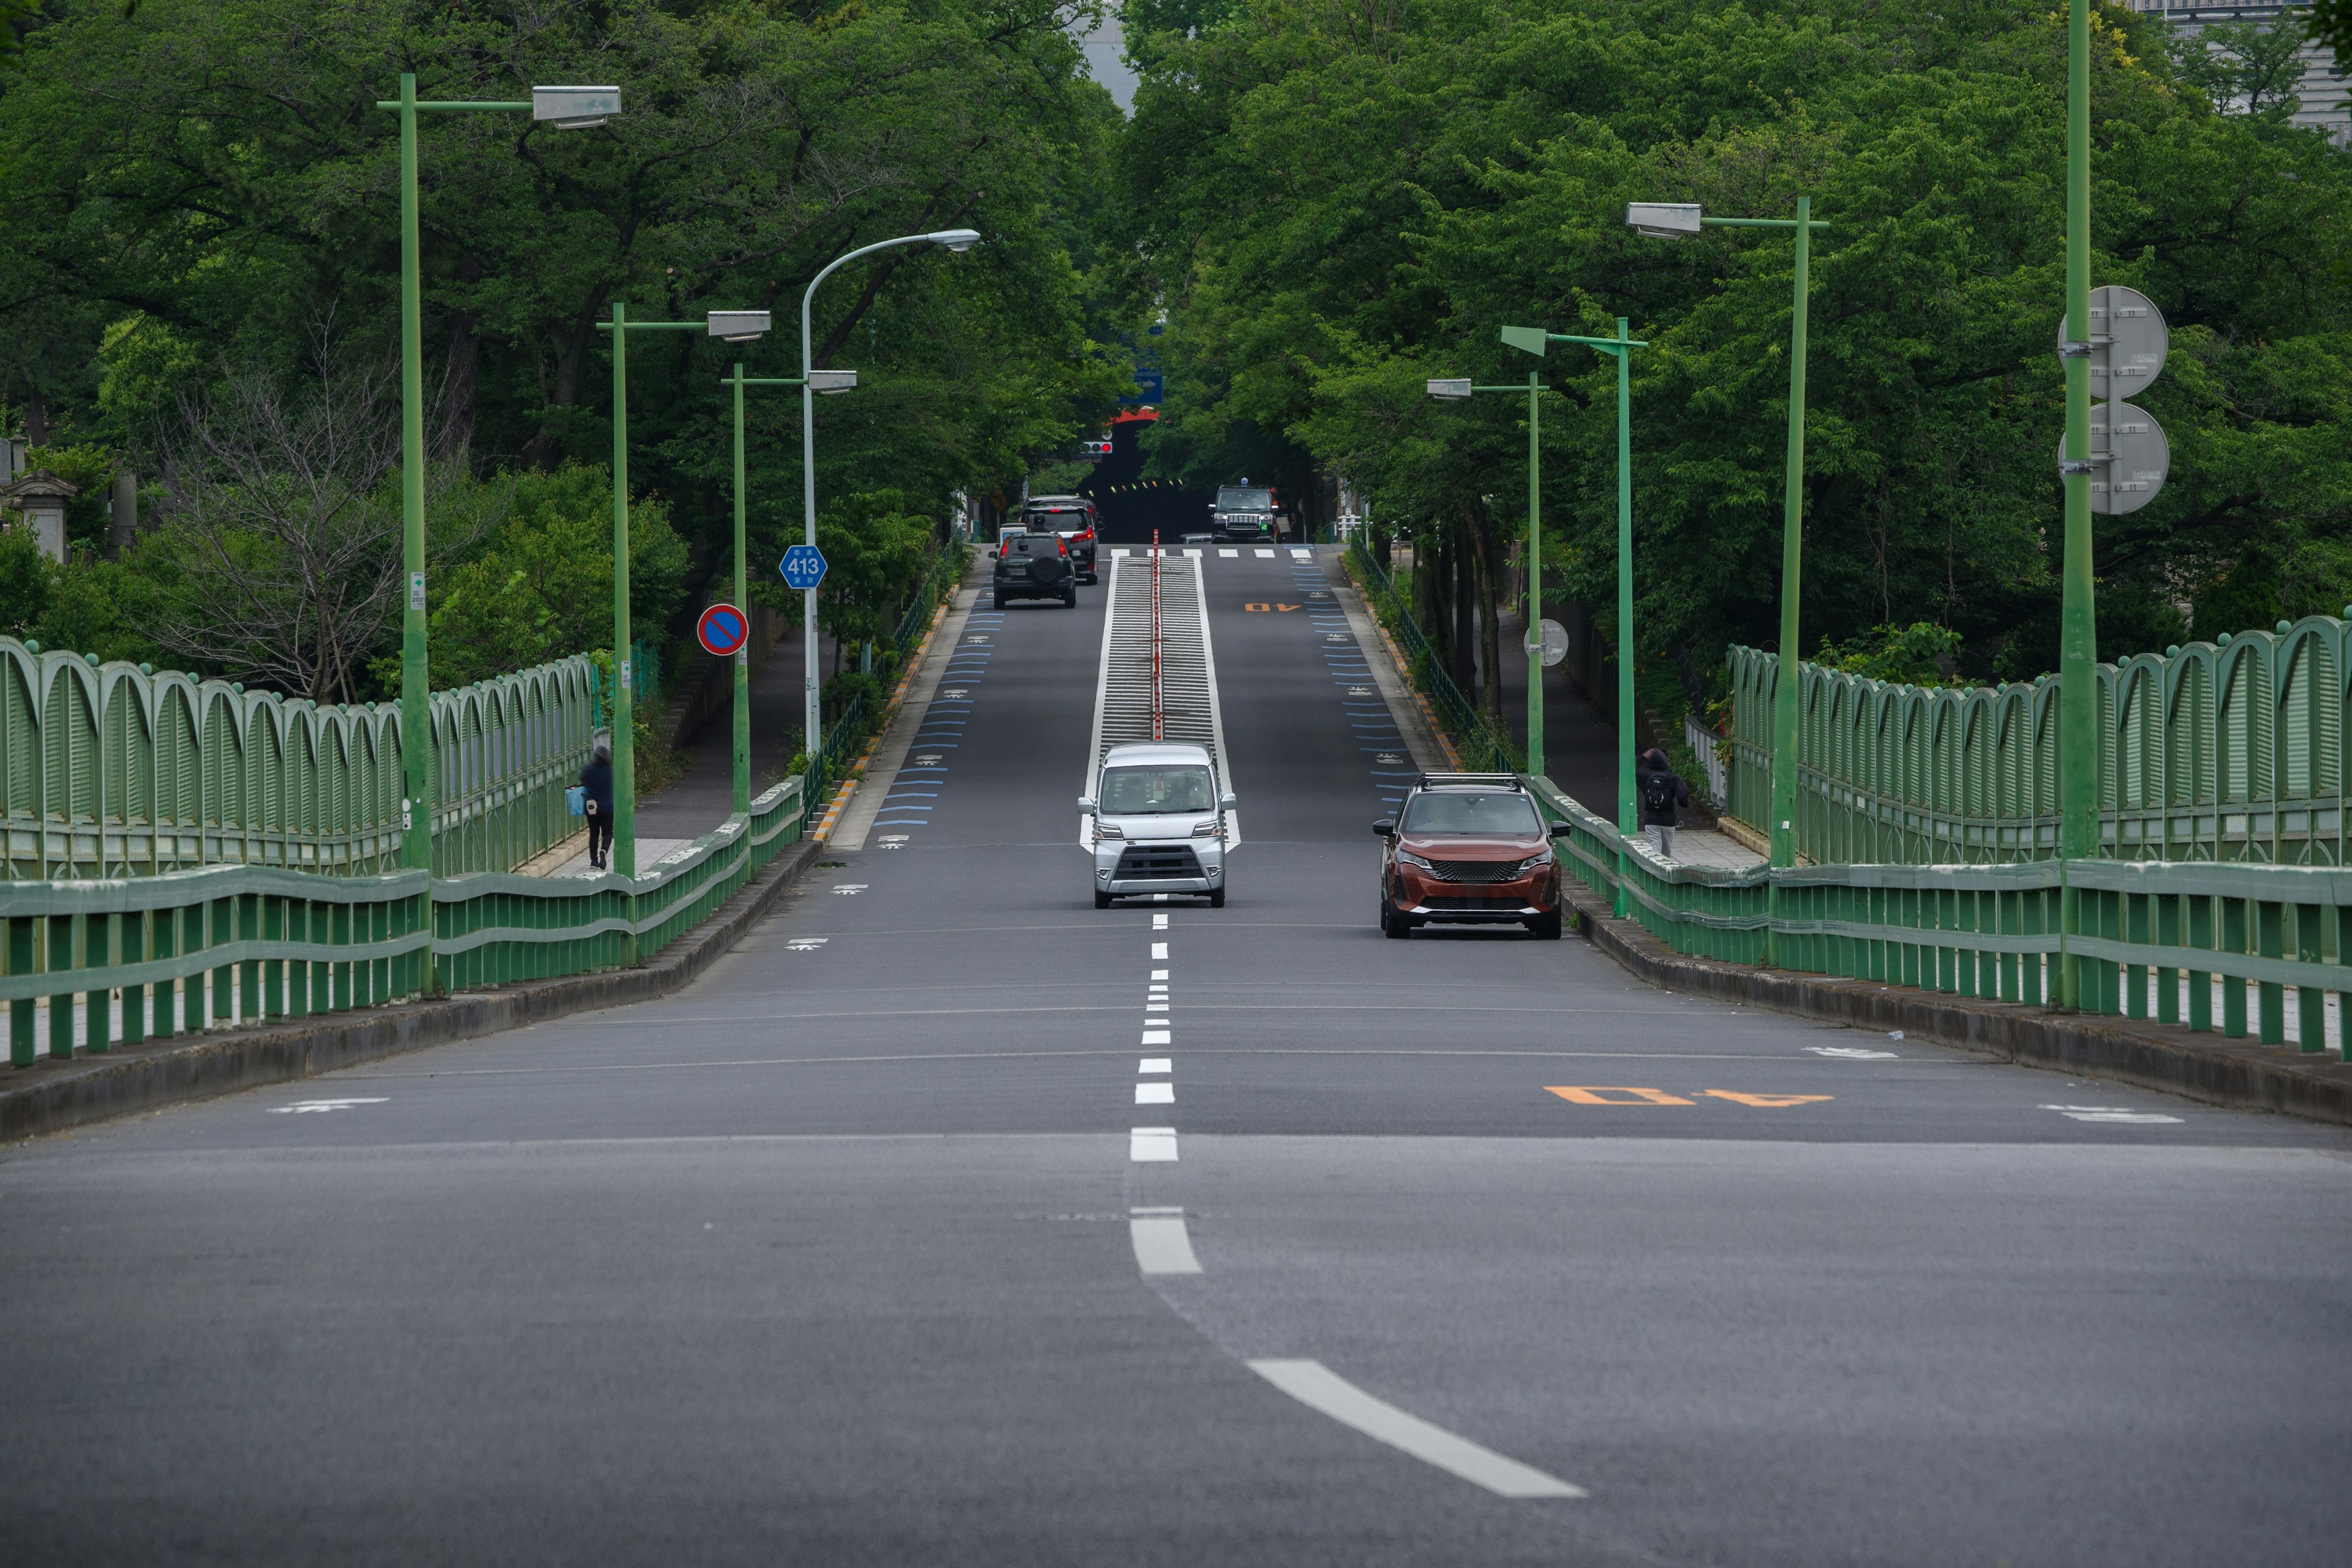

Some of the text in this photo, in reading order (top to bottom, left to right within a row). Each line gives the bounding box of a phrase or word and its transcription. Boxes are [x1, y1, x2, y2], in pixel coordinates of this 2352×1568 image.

[788, 558, 819, 575] 413
[1245, 603, 1301, 611] 40
[1542, 1086, 1834, 1107] 40
